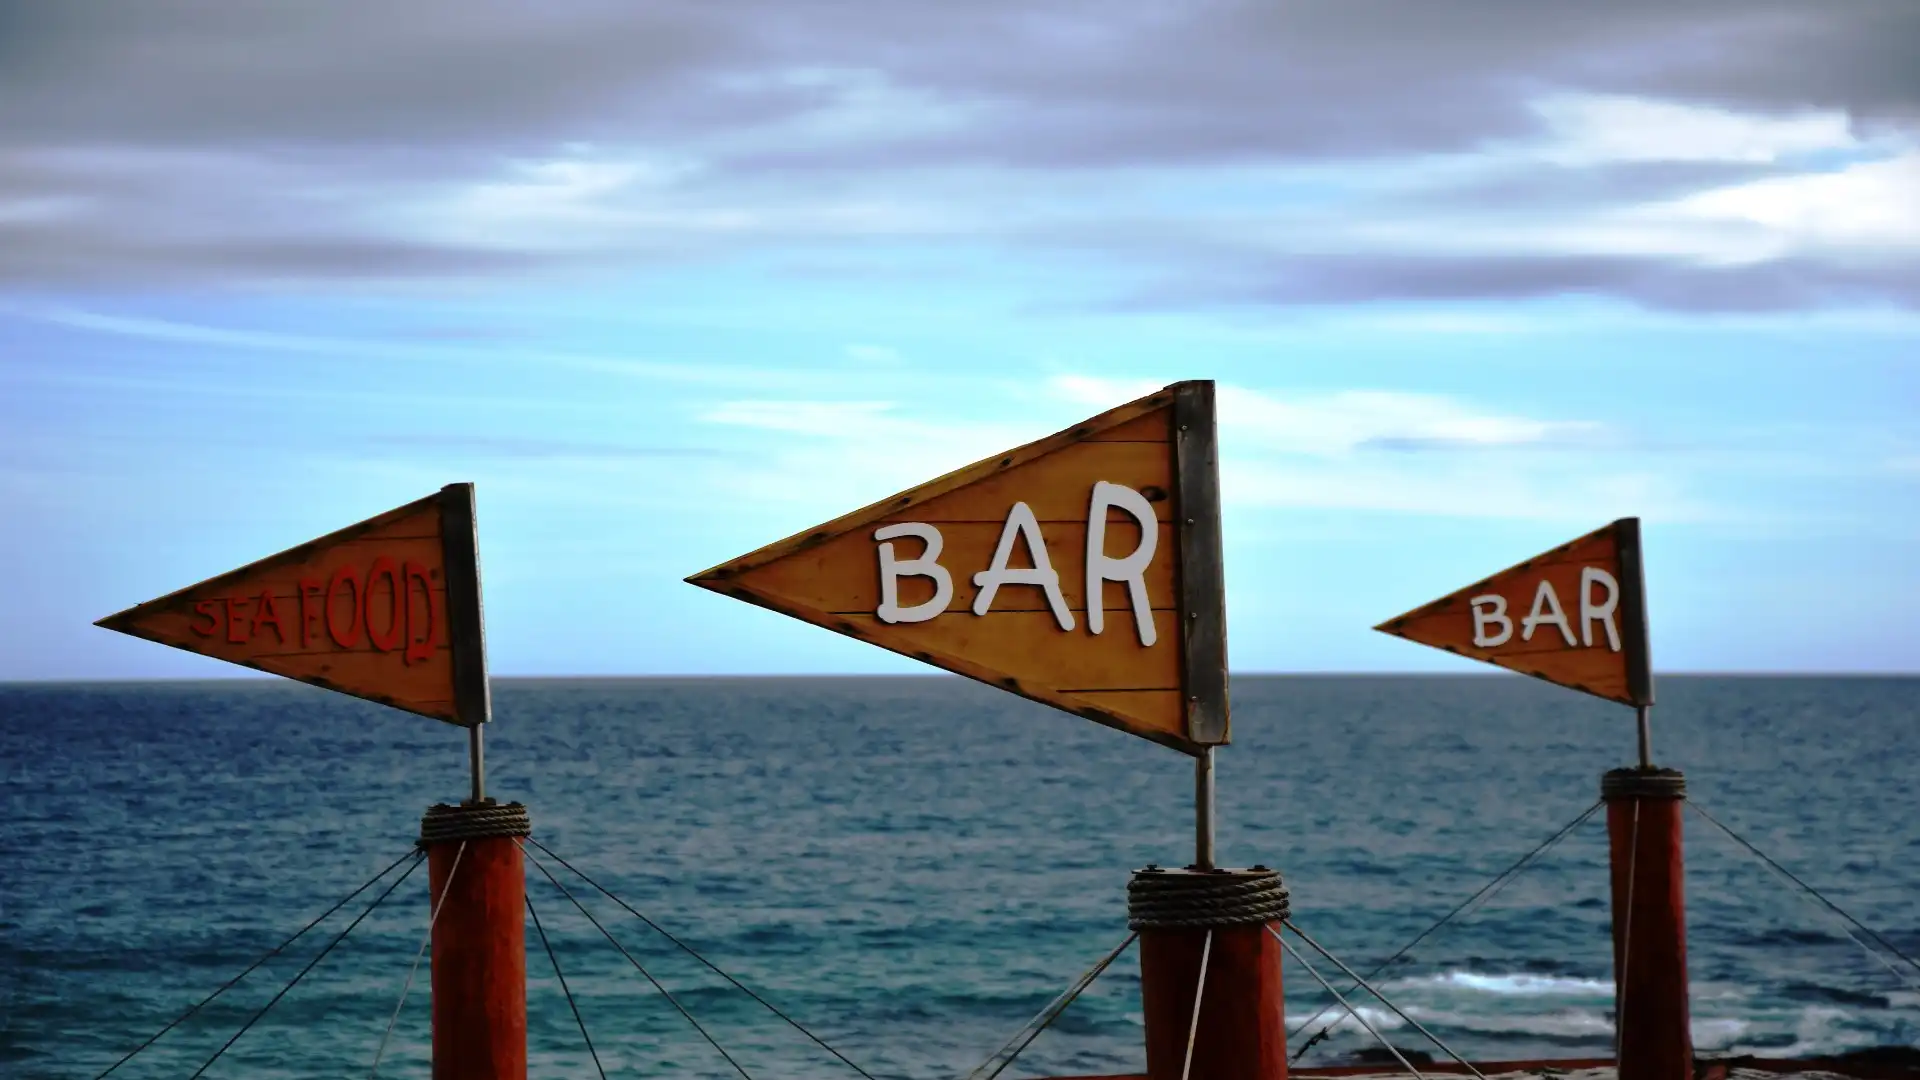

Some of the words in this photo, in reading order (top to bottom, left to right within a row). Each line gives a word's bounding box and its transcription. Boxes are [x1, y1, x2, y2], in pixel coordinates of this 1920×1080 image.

[190, 589, 284, 646] SEA
[299, 556, 438, 667] FOOD
[873, 480, 1159, 647] BAR
[1470, 566, 1622, 652] BAR
